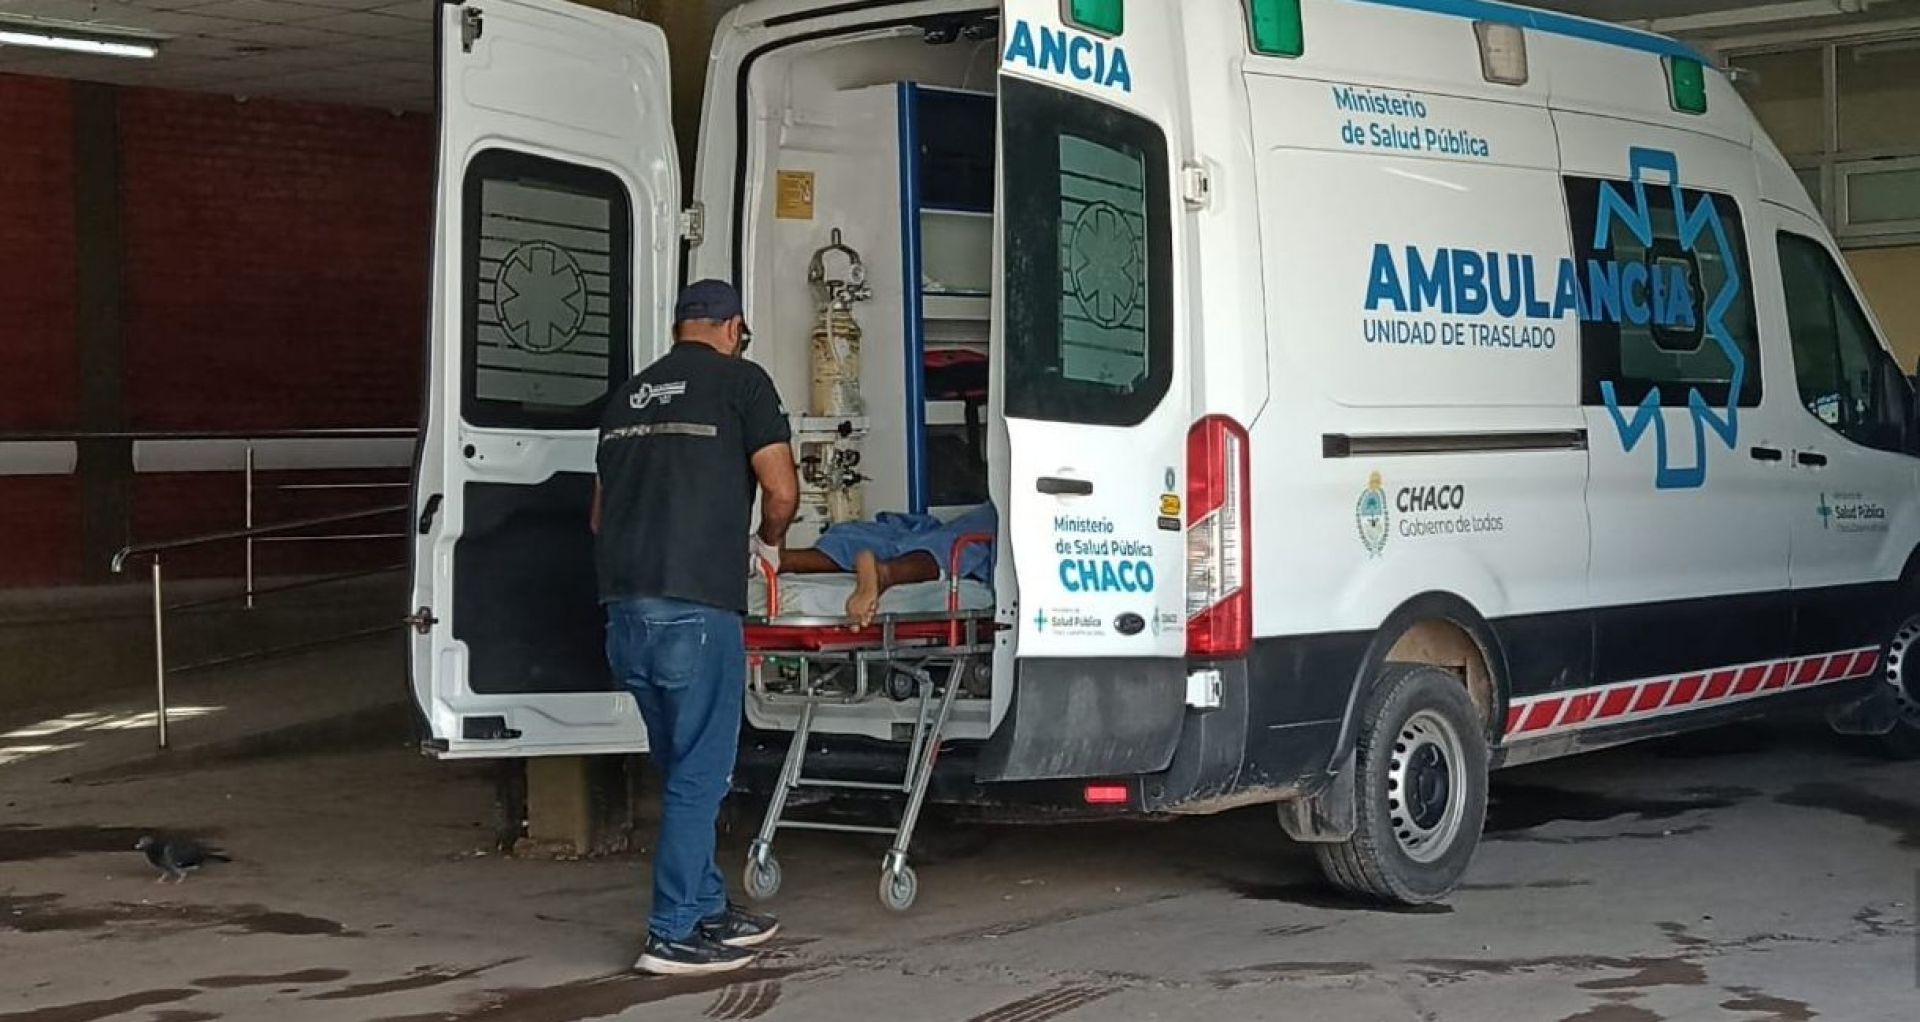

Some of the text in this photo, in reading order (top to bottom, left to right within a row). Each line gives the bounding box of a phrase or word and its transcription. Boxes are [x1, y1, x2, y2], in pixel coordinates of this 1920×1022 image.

[1005, 19, 1131, 92] ANCIA
[1332, 86, 1427, 118] Ministerio
[1341, 120, 1489, 156] de Salud Pública
[1363, 243, 1696, 326] AMBULANCIA
[1363, 319, 1556, 349] UNIDAD DE TRASLADO
[1396, 484, 1464, 512] CHACO
[1054, 515, 1114, 533] Ministerio
[1399, 512, 1504, 537] Gobierno de todos
[1056, 538, 1153, 557] de Salud Pública
[1059, 559, 1154, 592] CHACO
